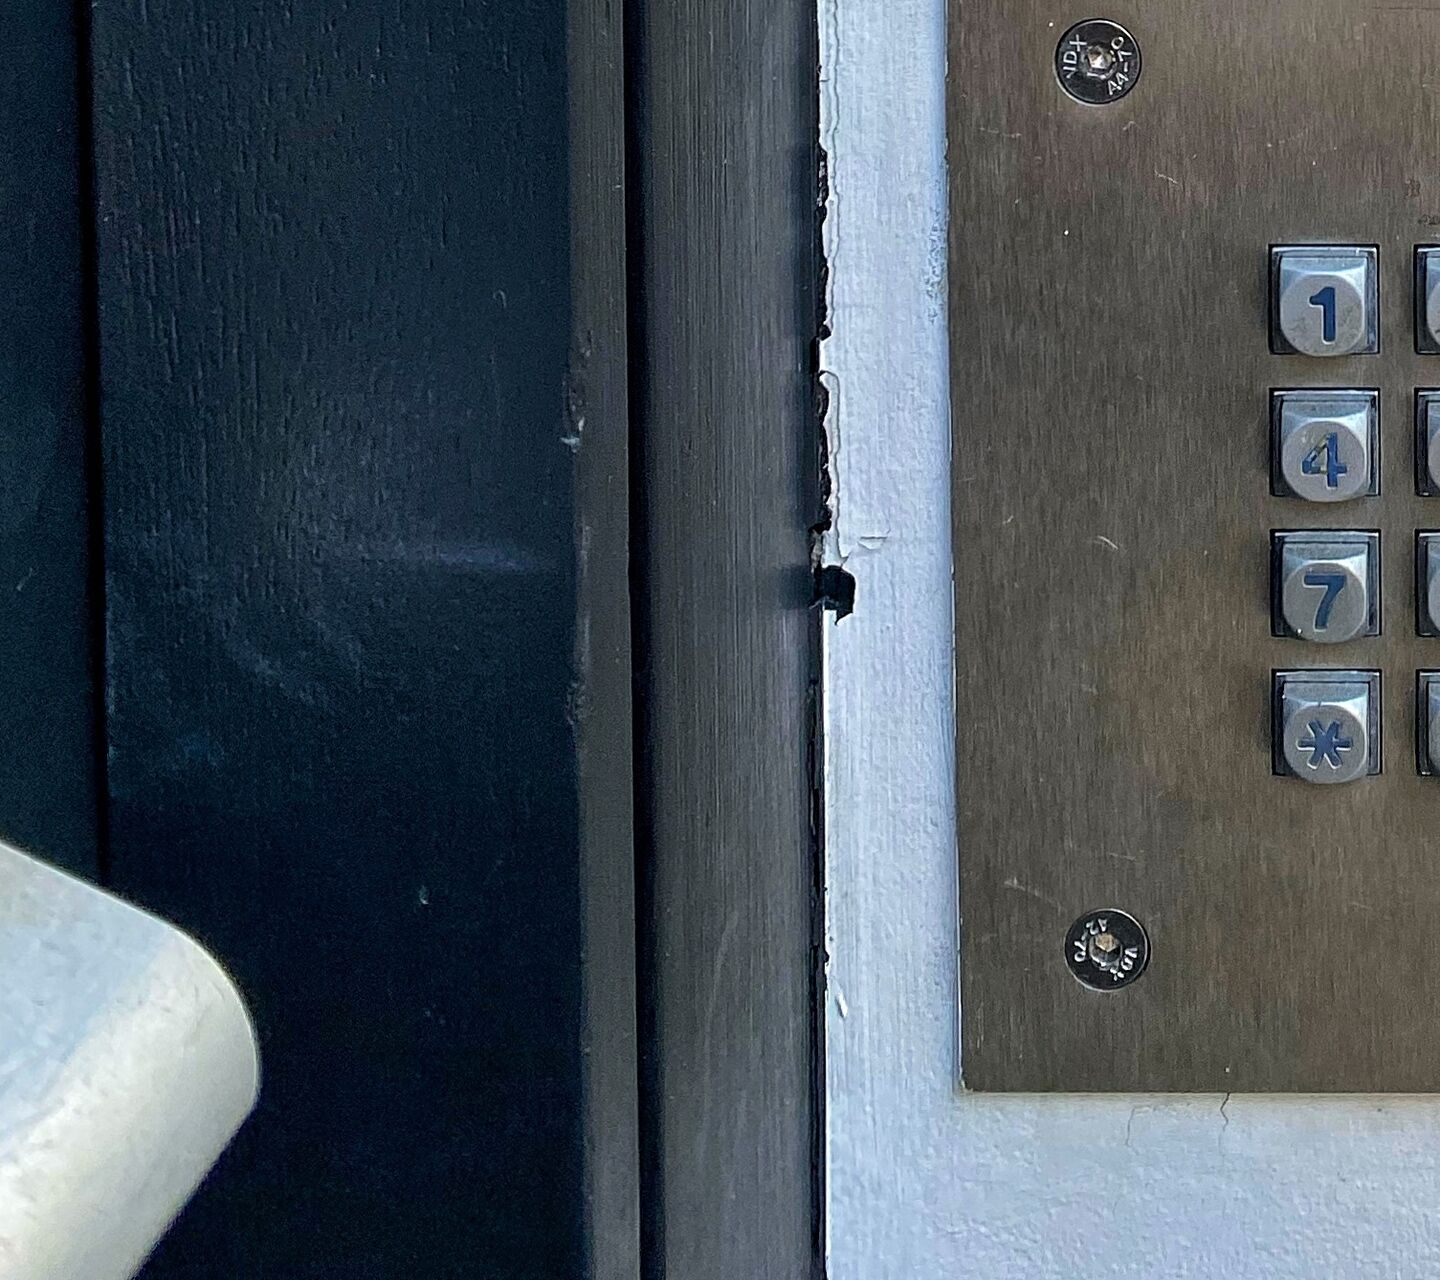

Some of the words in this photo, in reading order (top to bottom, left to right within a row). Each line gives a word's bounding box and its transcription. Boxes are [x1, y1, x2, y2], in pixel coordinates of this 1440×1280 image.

[1062, 33, 1088, 79] VDX
[1107, 36, 1133, 96] A4-70
[1308, 286, 1337, 344] 1
[1301, 431, 1348, 488] 4
[1303, 574, 1346, 631] 7
